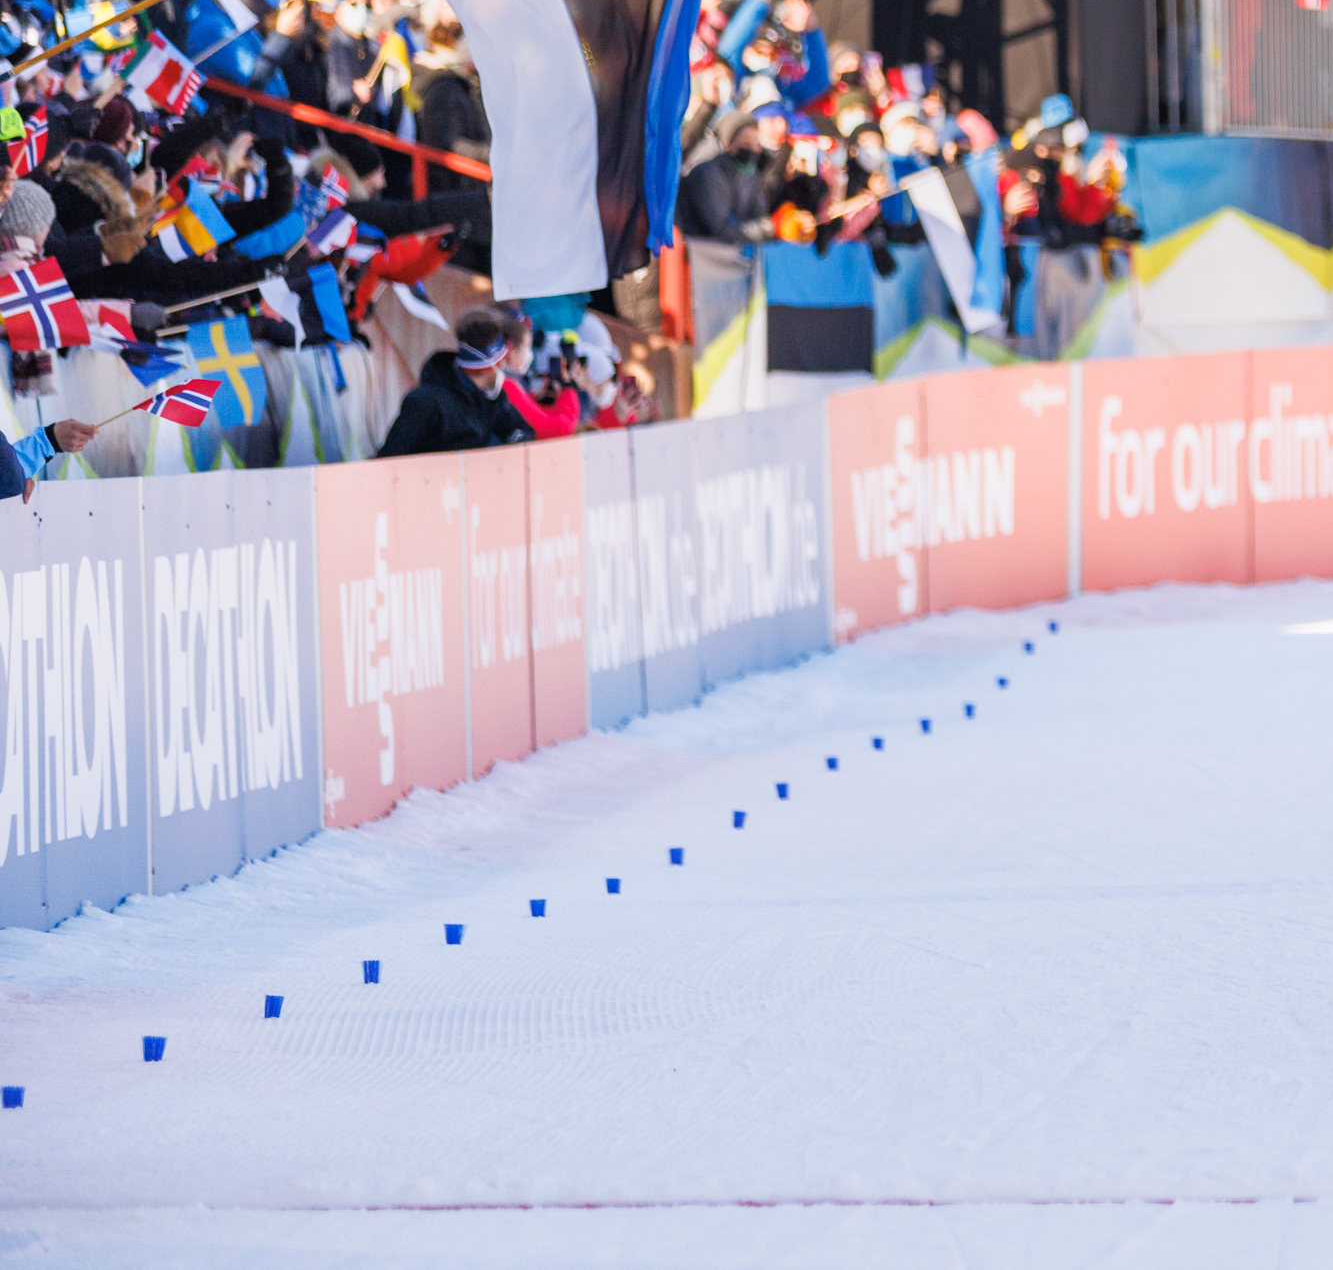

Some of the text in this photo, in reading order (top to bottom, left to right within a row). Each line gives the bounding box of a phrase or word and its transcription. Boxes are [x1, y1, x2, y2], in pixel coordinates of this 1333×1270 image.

[1098, 394, 1166, 520] for
[1171, 418, 1246, 512] our
[155, 536, 303, 818] DECATHLON
